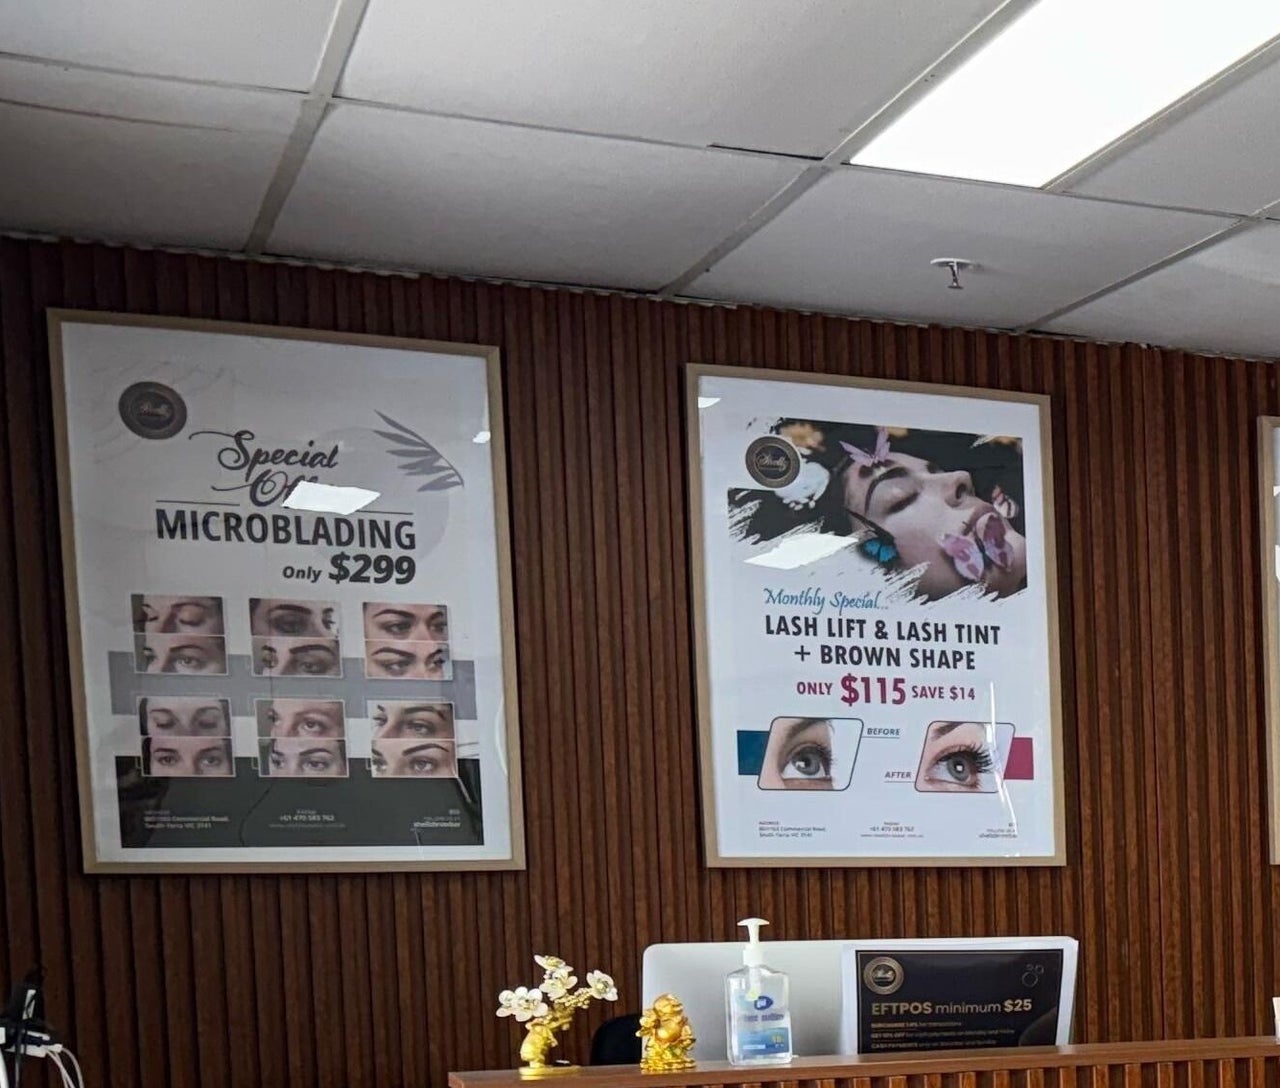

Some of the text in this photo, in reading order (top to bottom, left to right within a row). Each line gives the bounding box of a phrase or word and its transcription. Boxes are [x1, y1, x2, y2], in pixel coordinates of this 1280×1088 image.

[189, 430, 339, 482] Special
[155, 508, 417, 551] MICROBLADING
[282, 551, 417, 585] Only $299
[763, 587, 826, 615] Monthly
[765, 615, 1001, 645] LASH LIFT & LASH TINT
[794, 644, 976, 670] + BROWN SHAPE
[796, 672, 976, 707] ONLY $115 SAVE $14
[866, 726, 901, 738] BEFORE
[884, 769, 912, 780] AFTER
[871, 999, 1032, 1015] EFTPOS minimum $25
